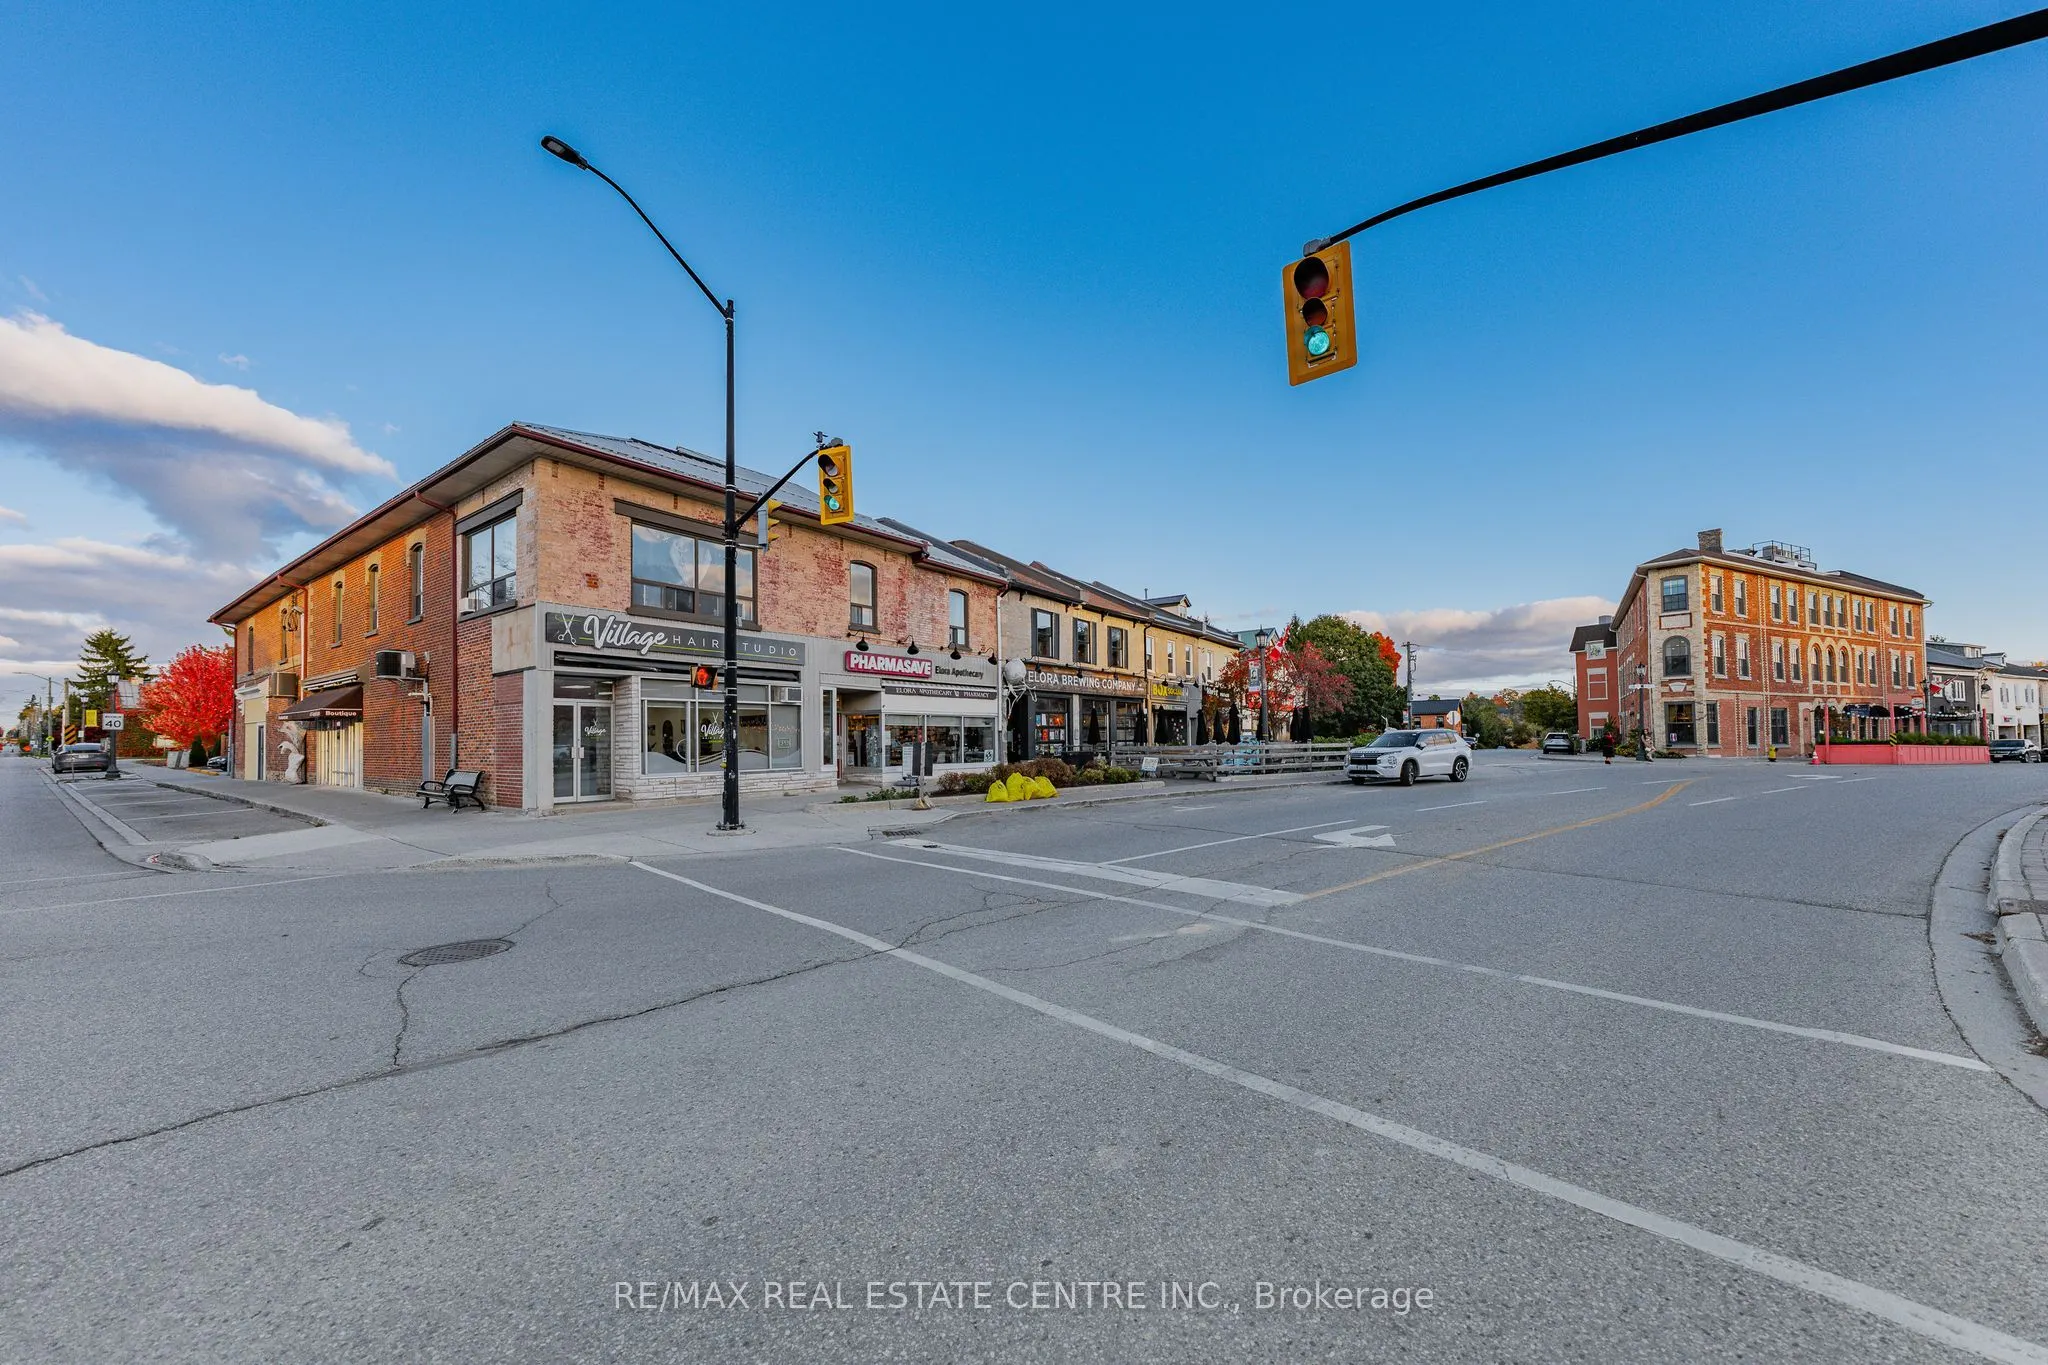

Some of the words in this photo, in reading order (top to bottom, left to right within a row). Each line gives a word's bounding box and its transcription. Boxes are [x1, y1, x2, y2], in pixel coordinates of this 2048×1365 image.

[583, 615, 668, 655] Village
[673, 634, 720, 649] HAIR
[741, 641, 797, 657] TUDIO
[850, 653, 932, 675] PHARMASAVE
[951, 667, 984, 680] Apothecary
[1028, 671, 1058, 685] ELORA
[1062, 675, 1100, 689] BREWING
[1101, 679, 1137, 691] COMPANY
[1152, 683, 1167, 697] BOX
[325, 710, 357, 718] Boutique
[105, 720, 122, 728] 40
[700, 723, 725, 738] Villag
